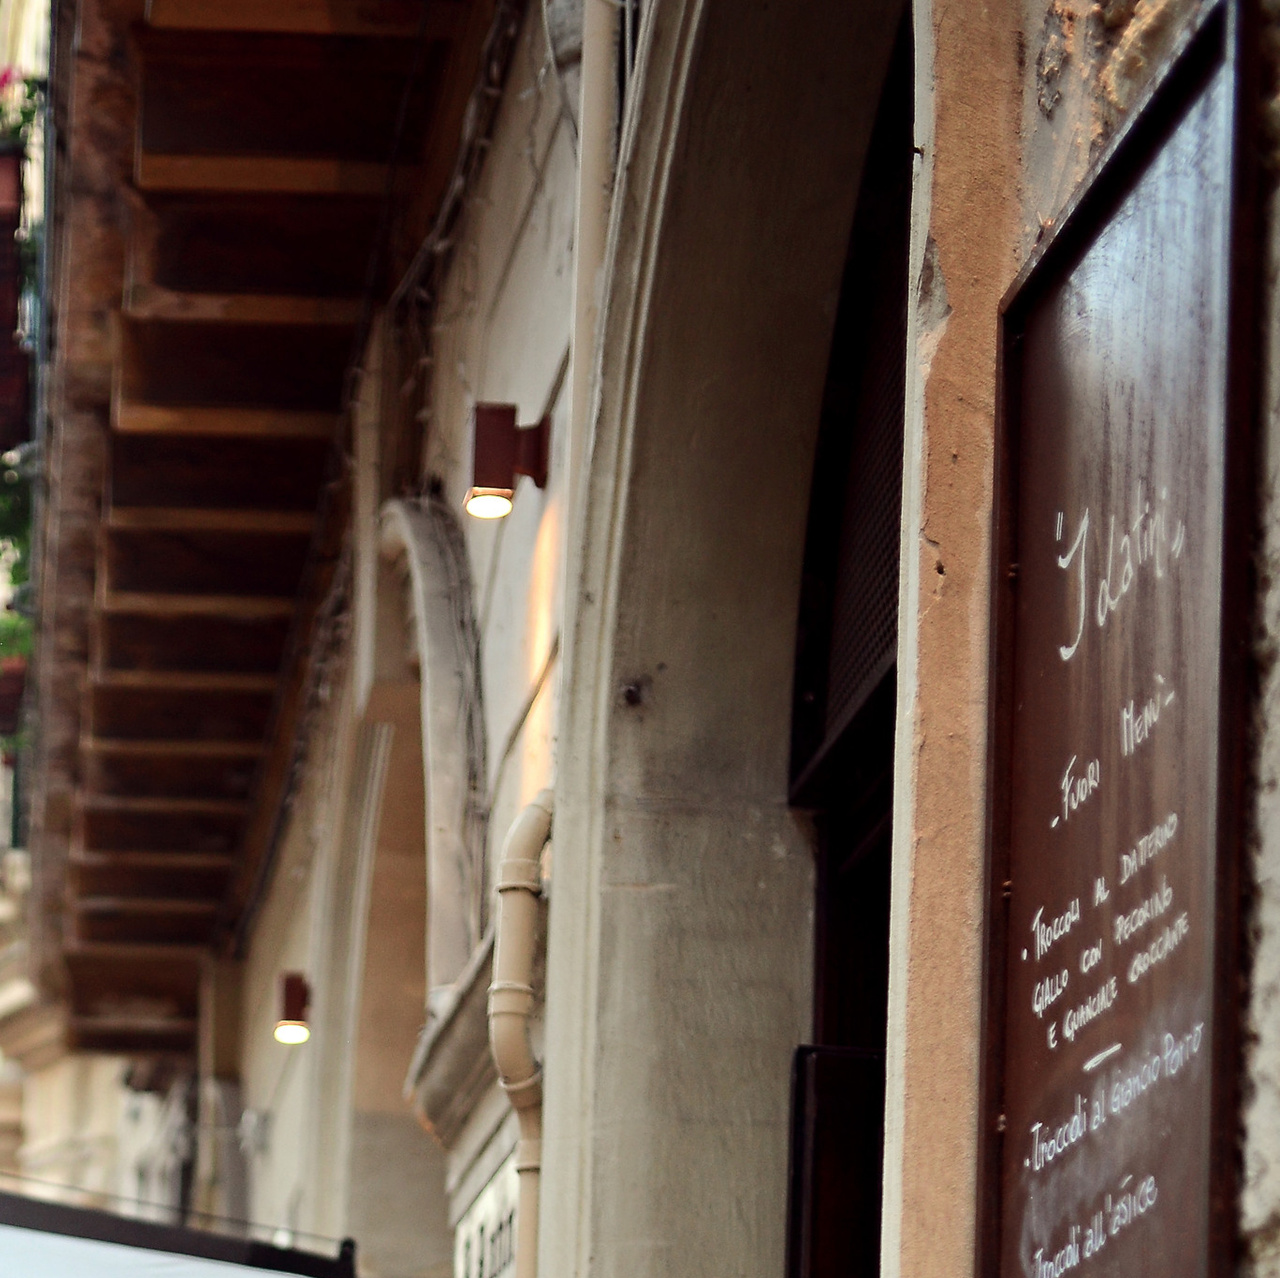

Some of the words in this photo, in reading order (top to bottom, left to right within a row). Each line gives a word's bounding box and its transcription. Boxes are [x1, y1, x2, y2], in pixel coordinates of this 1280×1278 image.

[1032, 897, 1081, 962] TROCCOLI
[1093, 876, 1111, 908] AL
[1033, 968, 1070, 1019] GIALLO
[1080, 938, 1104, 975] CON
[1047, 1022, 1059, 1050] E
[1063, 976, 1119, 1042] GUANCIALE
